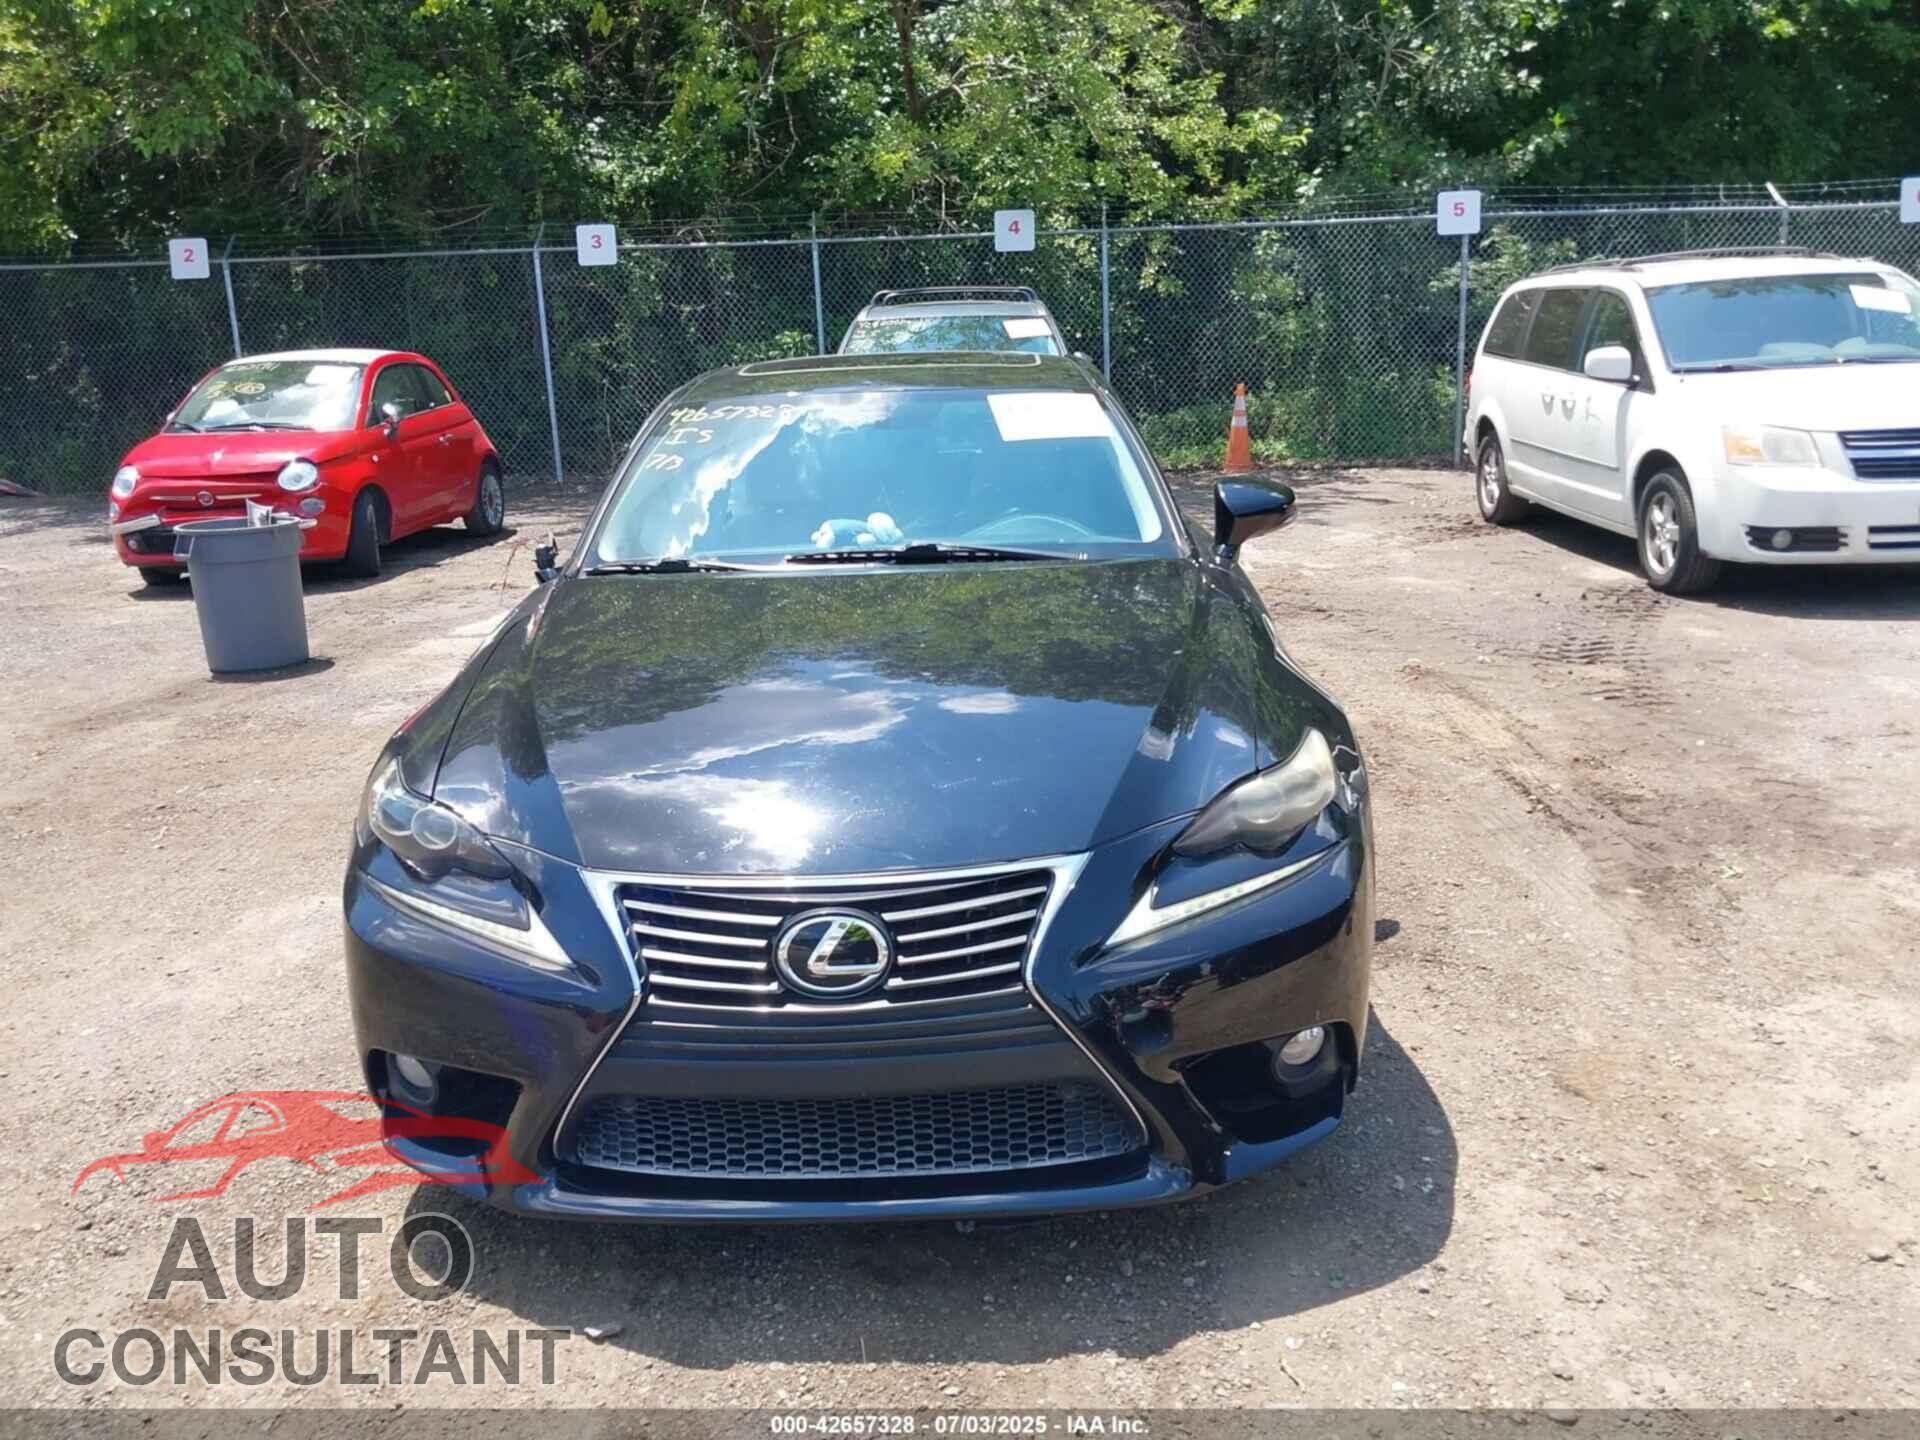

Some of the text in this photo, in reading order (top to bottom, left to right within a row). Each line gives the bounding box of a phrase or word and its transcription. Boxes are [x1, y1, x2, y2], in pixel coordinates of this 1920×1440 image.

[1454, 202, 1465, 217] 5
[1008, 220, 1021, 235] 4
[591, 234, 602, 249] 3
[183, 248, 194, 263] 2
